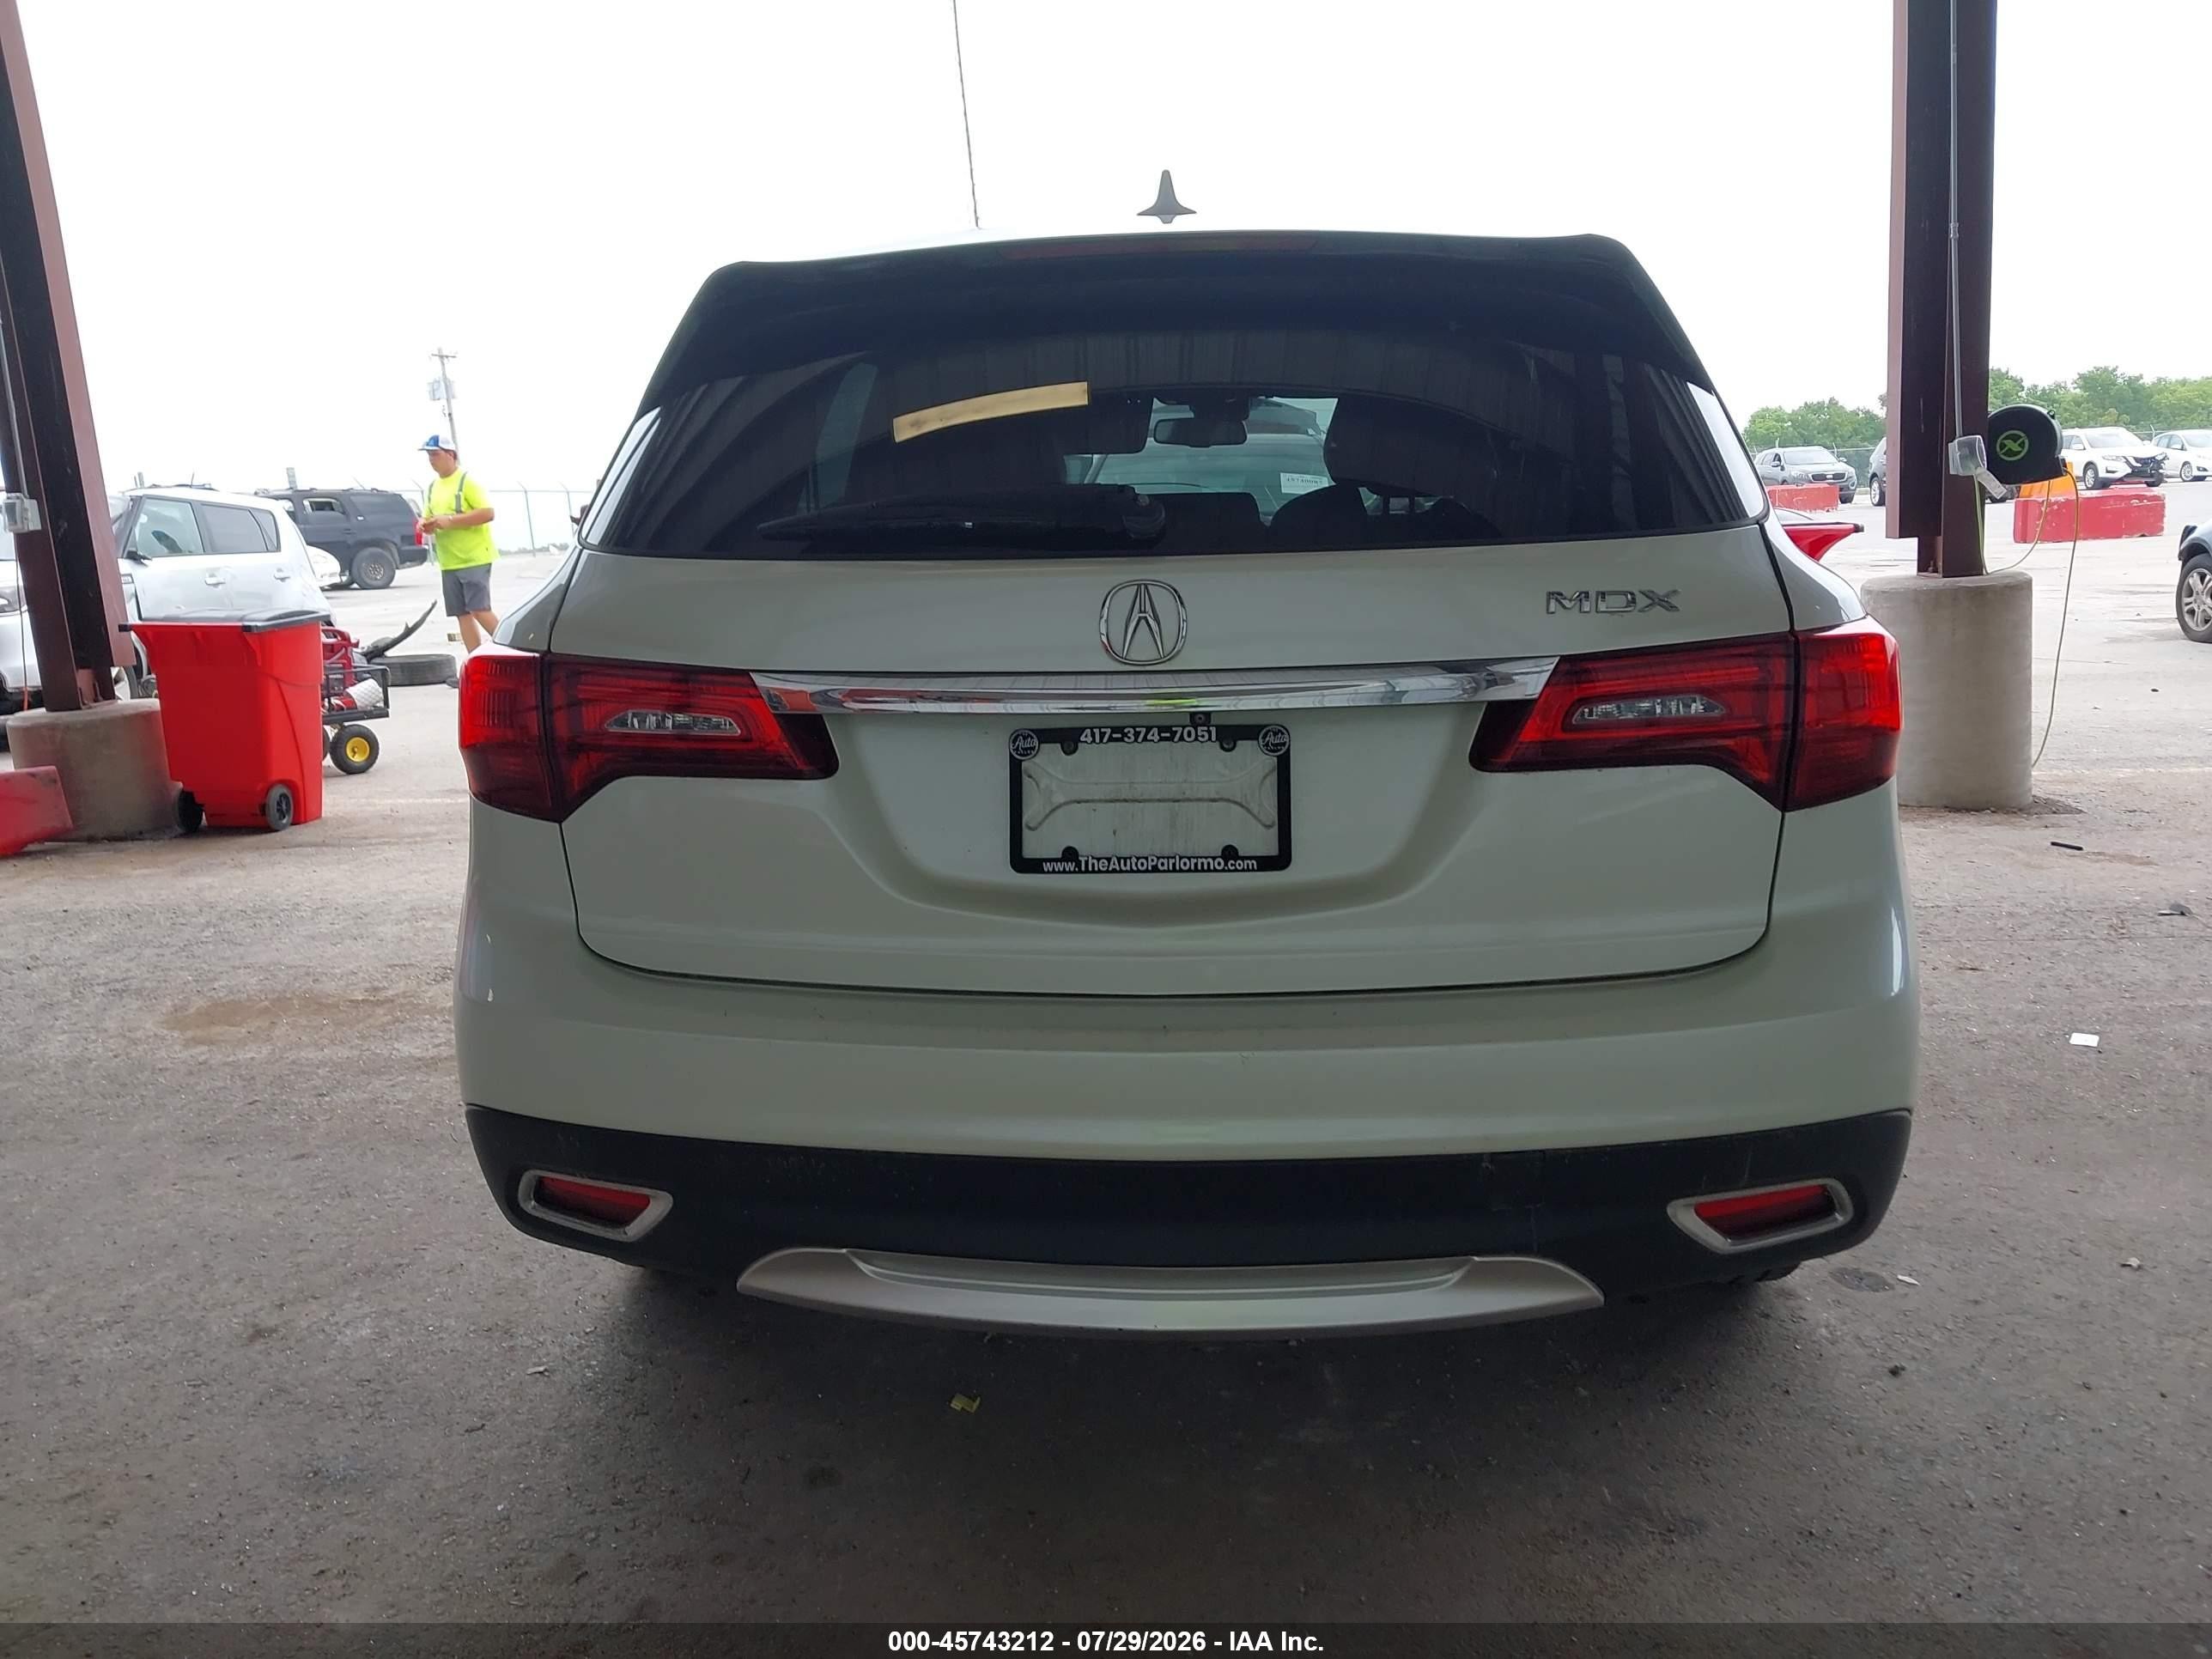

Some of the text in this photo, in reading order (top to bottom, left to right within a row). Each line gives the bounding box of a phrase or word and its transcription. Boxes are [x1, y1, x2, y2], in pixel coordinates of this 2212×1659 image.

[1547, 590, 1680, 614] MDX
[1079, 726, 1216, 744] 417-374-7051
[1042, 855, 1257, 872] www.TheAutoParlormo.com
